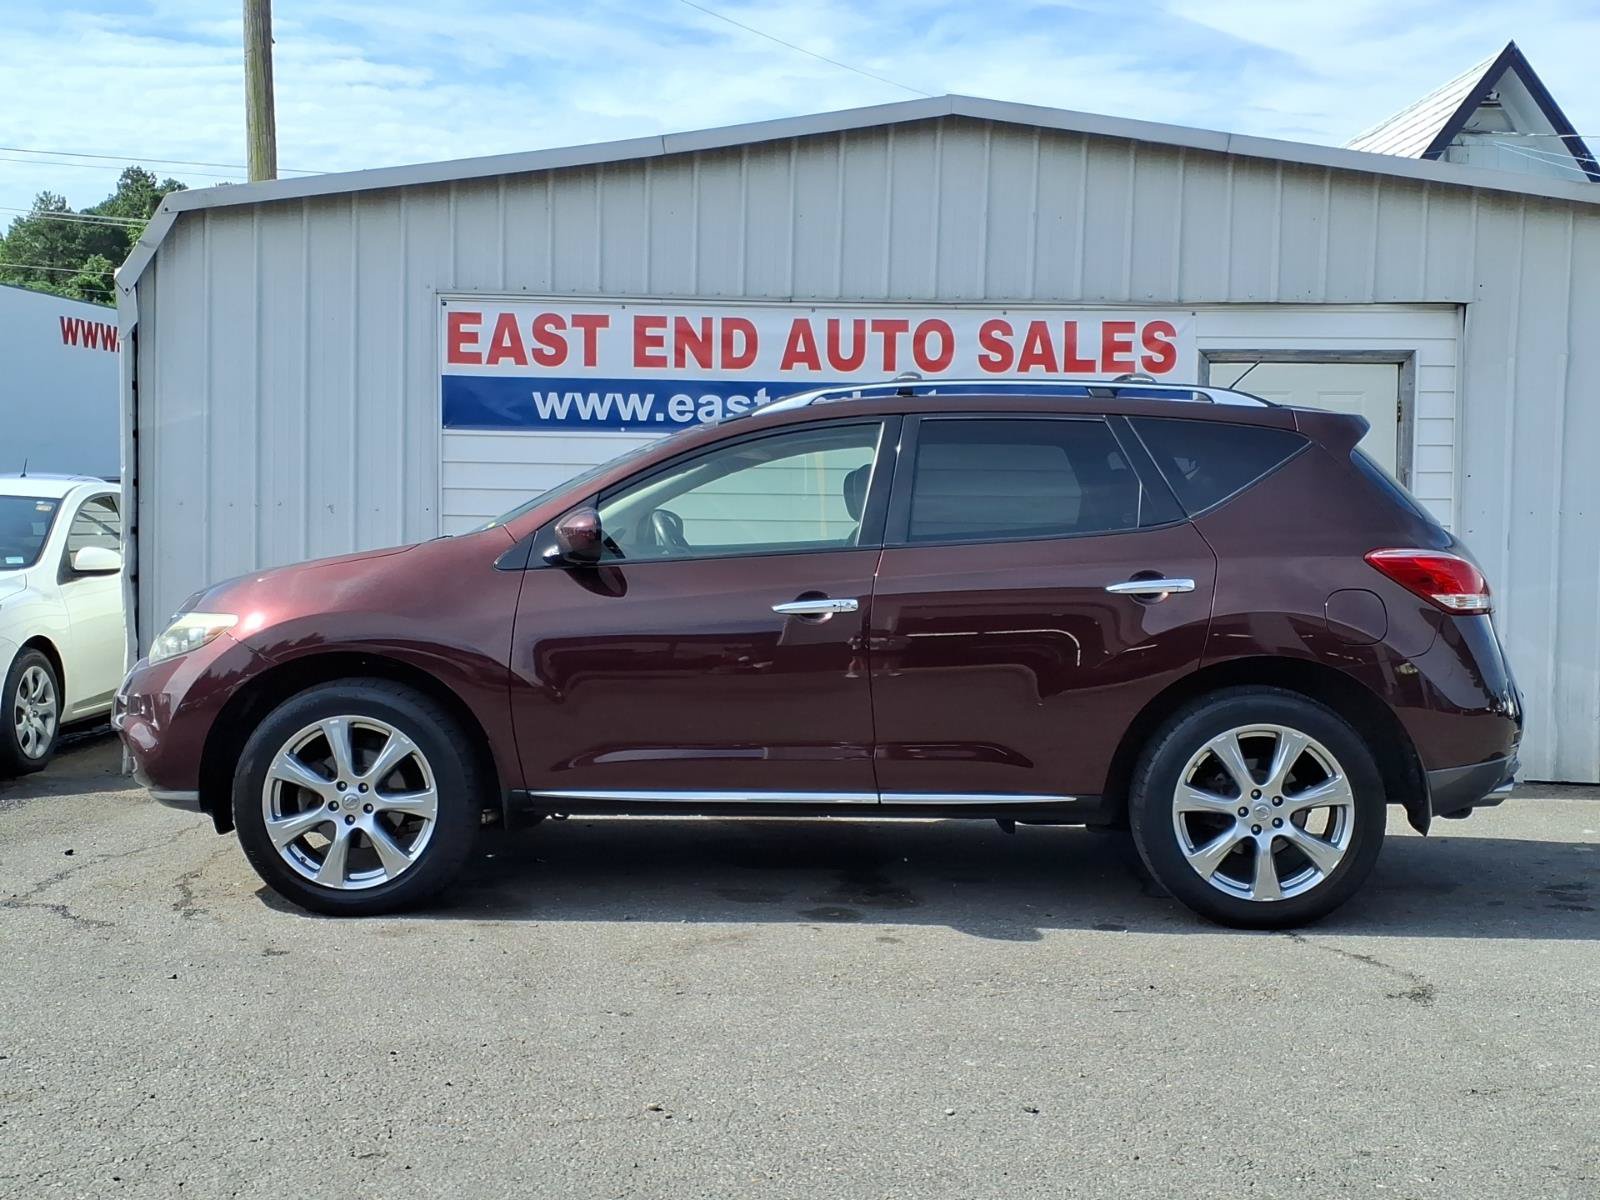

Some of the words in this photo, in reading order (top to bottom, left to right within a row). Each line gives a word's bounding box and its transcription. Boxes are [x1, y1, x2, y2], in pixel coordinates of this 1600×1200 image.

[447, 311, 610, 368] EAST
[633, 315, 760, 370] END
[779, 318, 956, 374] AUTO
[977, 319, 1178, 375] SALES
[532, 386, 786, 423] www.east
